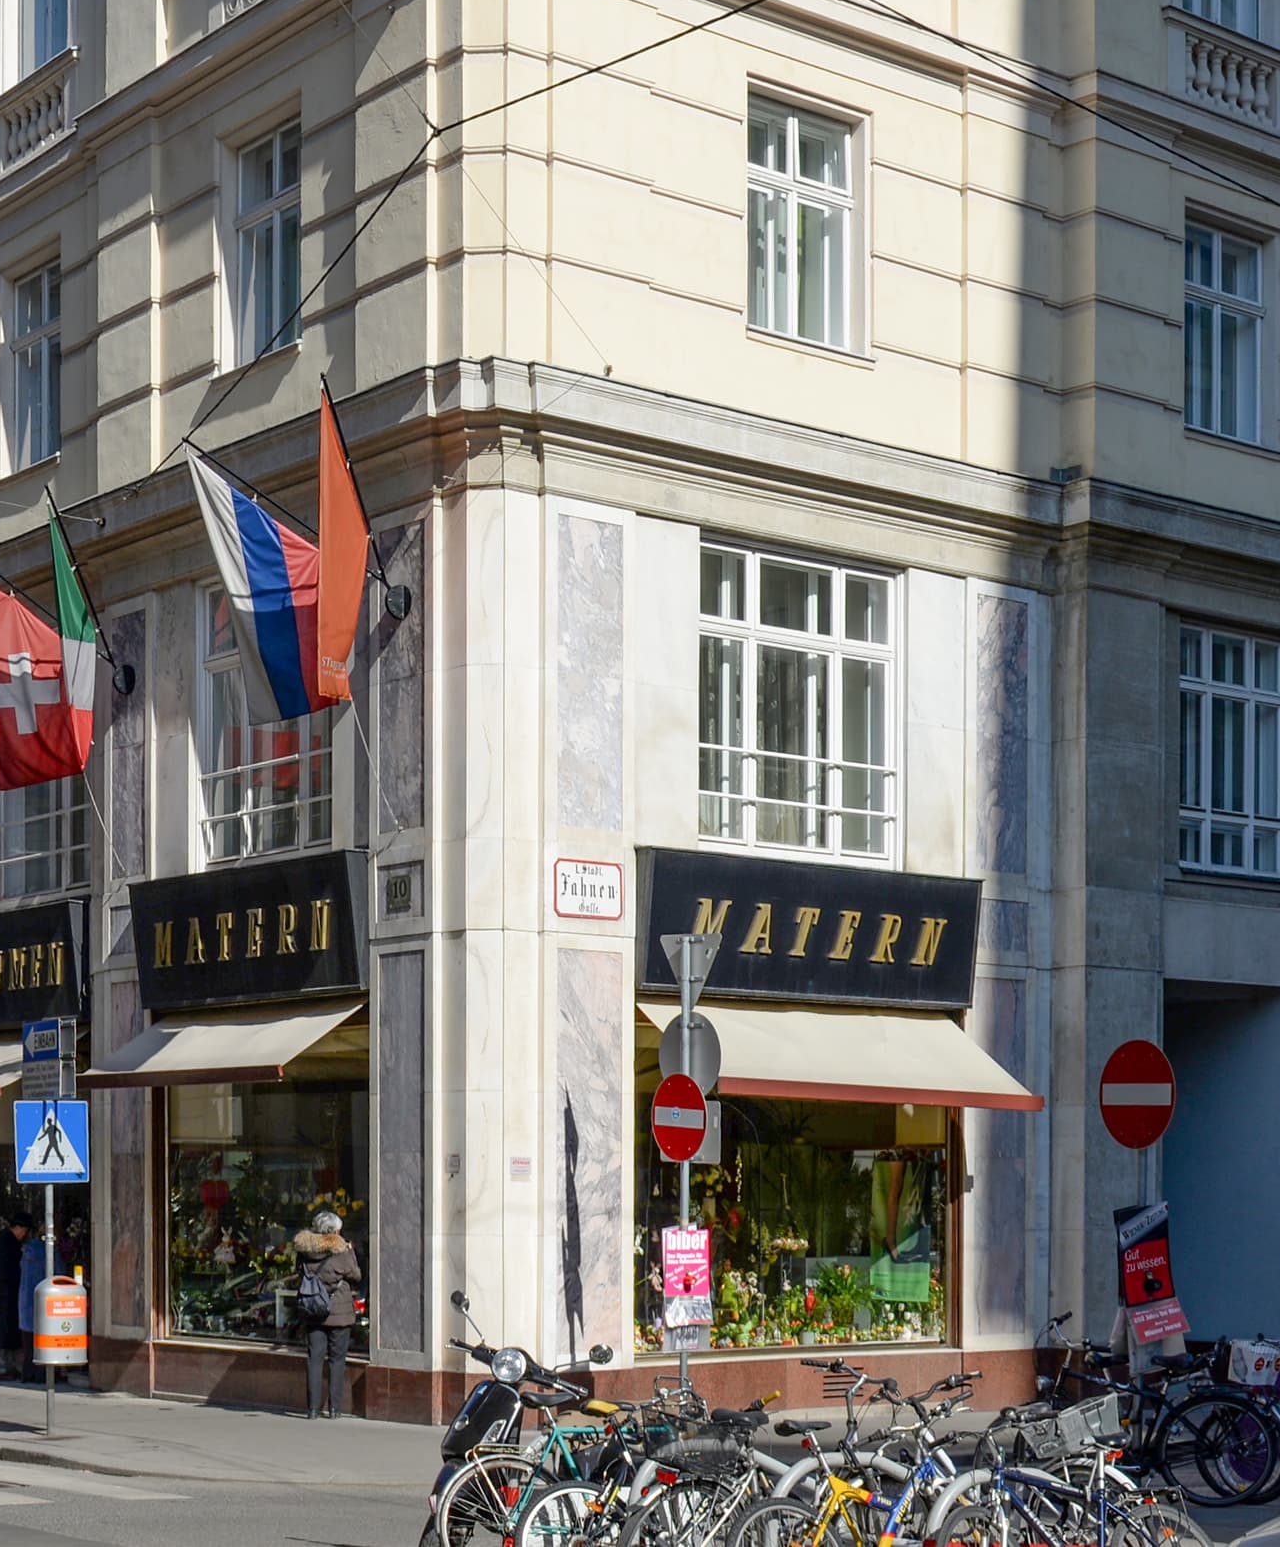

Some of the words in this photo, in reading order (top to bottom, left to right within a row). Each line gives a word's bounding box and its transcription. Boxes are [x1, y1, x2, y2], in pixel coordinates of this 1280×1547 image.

[393, 879, 407, 899] 10
[152, 898, 333, 969] MATERN
[691, 897, 949, 967] MATERN
[34, 1032, 56, 1050] EINBAHN
[667, 1230, 707, 1250] biber
[1124, 1249, 1140, 1262] Gut
[1126, 1262, 1136, 1273] zu
[1137, 1255, 1167, 1270] wissen.
